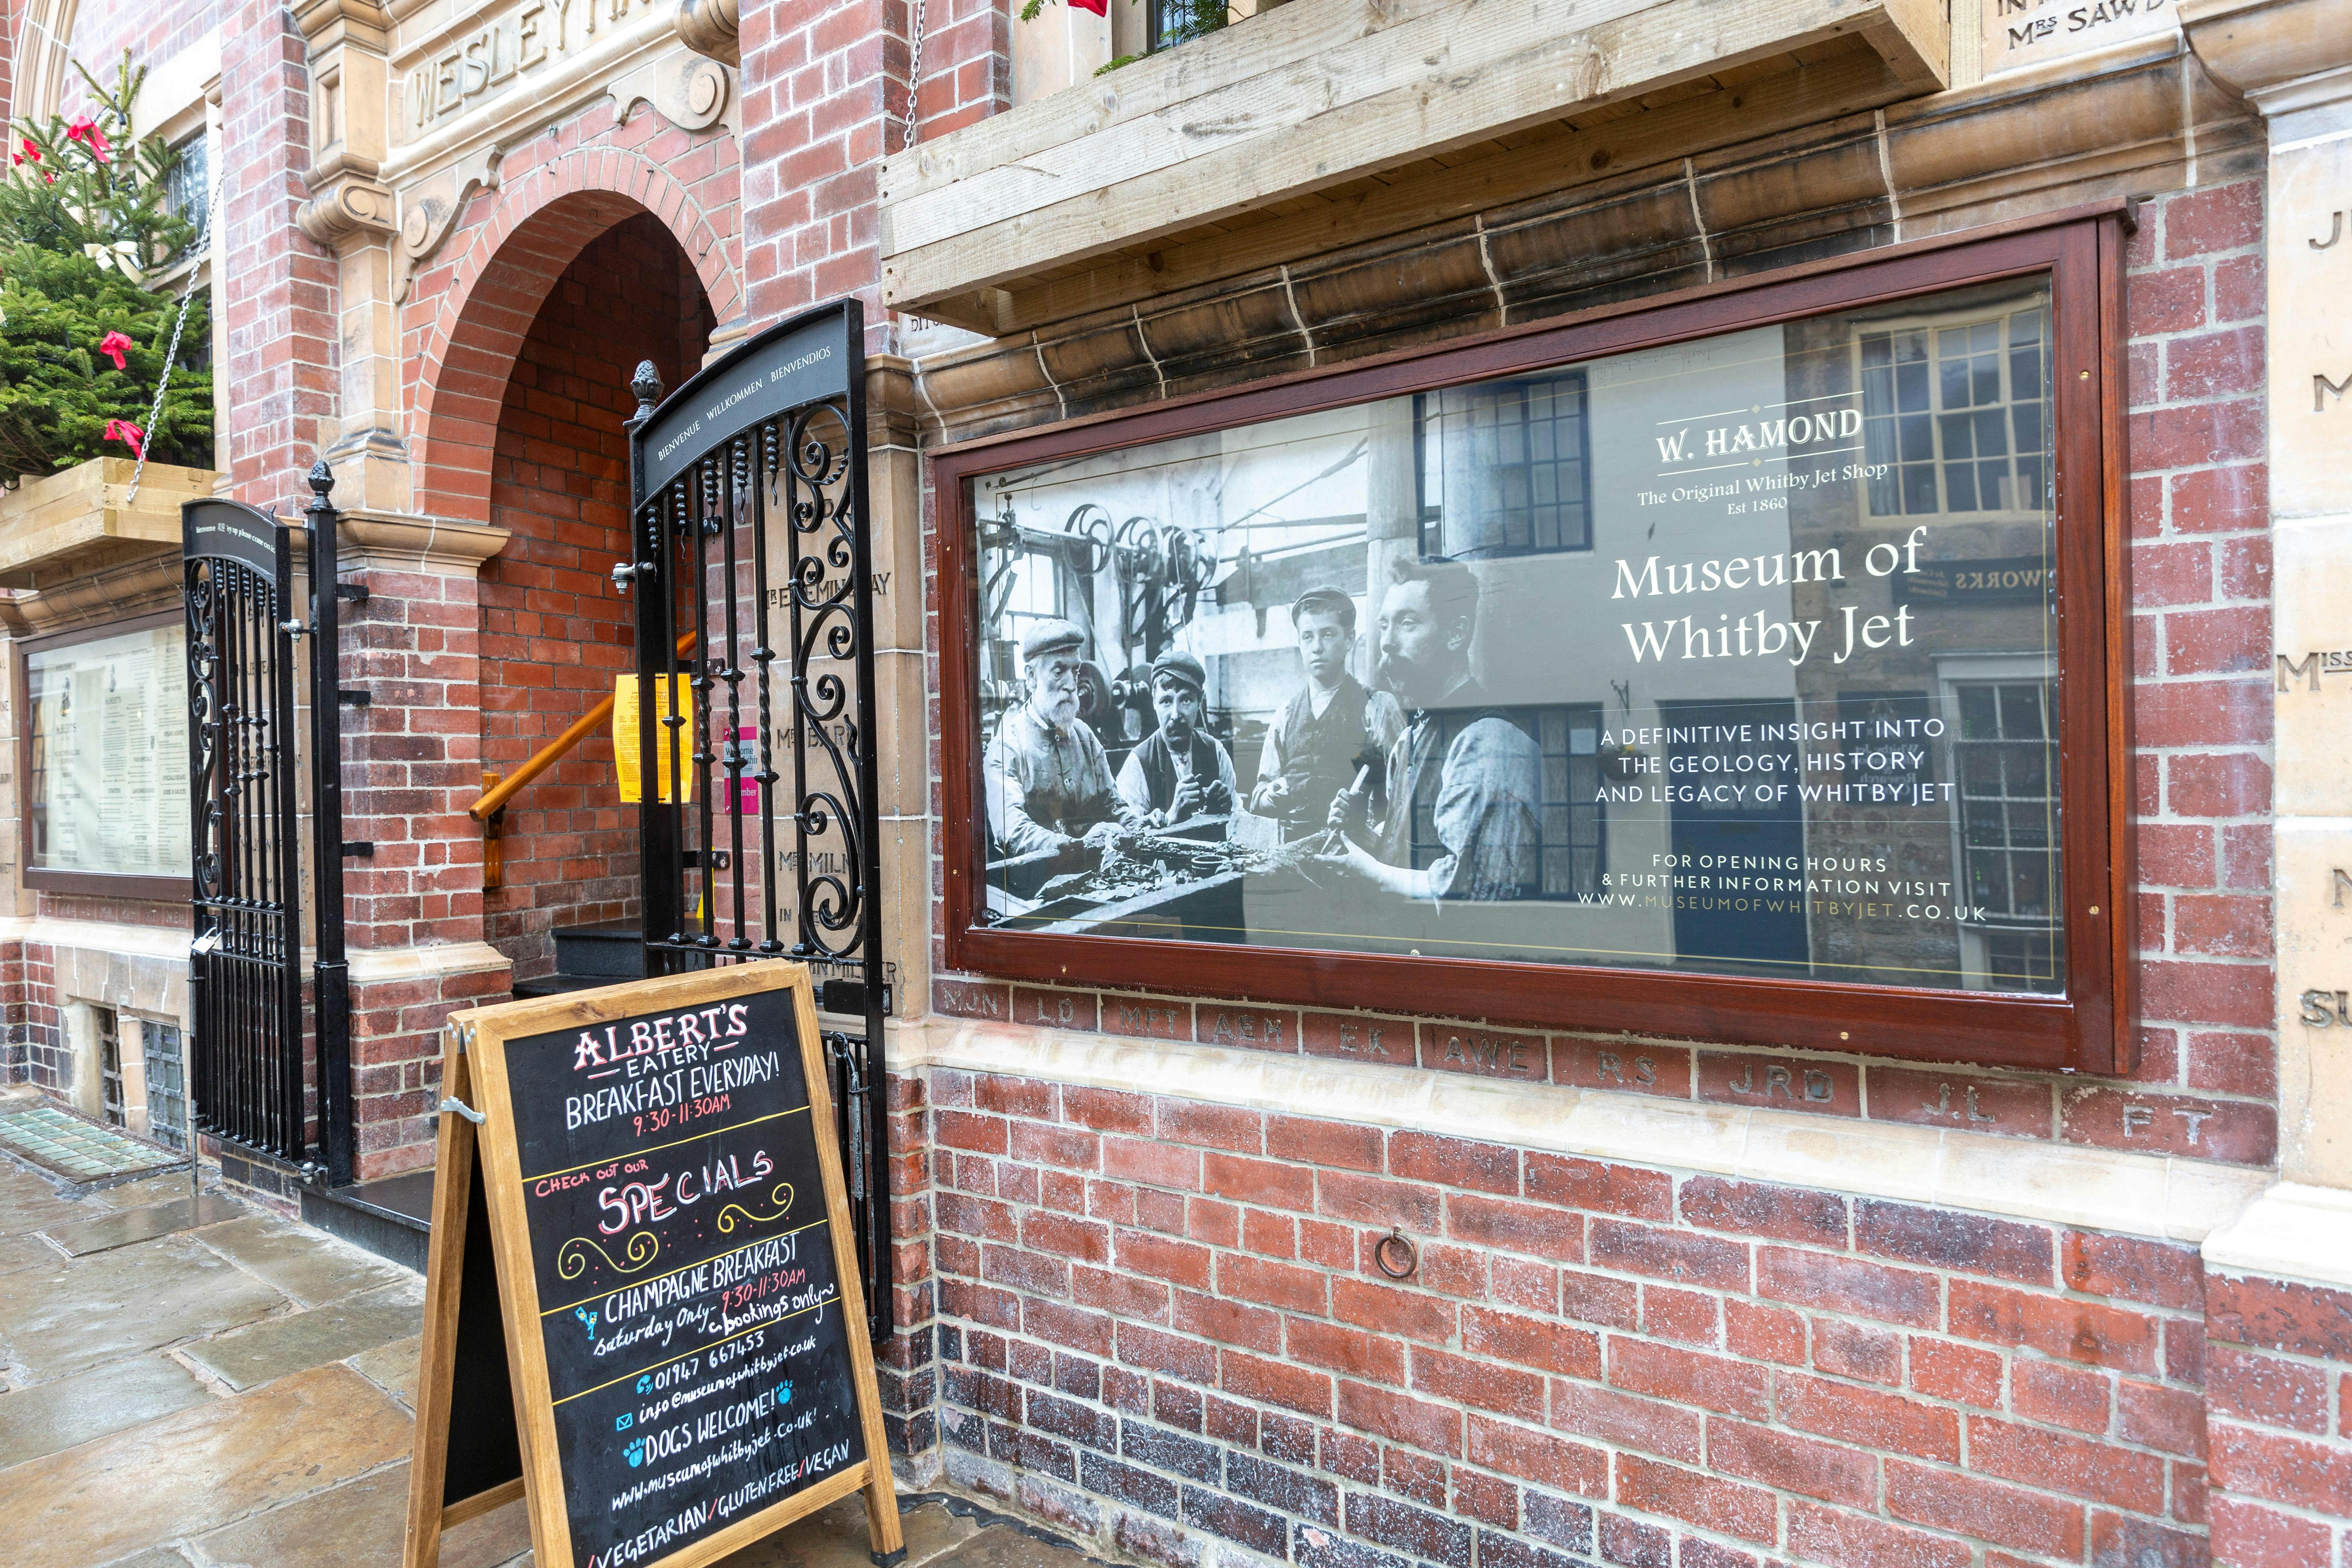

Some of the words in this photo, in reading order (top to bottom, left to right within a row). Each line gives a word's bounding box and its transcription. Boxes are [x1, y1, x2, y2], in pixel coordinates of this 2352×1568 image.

[658, 420, 701, 461] BIENVENUE
[706, 378, 763, 421] WILLKOMMEN
[770, 346, 831, 383] BIENVENDIOS
[1656, 427, 1695, 464] W.
[1705, 409, 1864, 457] HAMOND
[1637, 492, 1667, 506] The
[1672, 480, 1740, 503] Original
[1746, 472, 1810, 492] Whitby
[1812, 469, 1837, 489] Jet
[1842, 463, 1888, 482] Shop
[1727, 502, 1746, 515] Est
[1752, 497, 1788, 512] 1860
[264, 541, 270, 550] on
[1611, 546, 1845, 599] Museum
[1865, 525, 1927, 577] of
[1621, 609, 1822, 666] Whitby
[1834, 604, 1915, 664] Jet
[1600, 730, 1615, 745] A
[1622, 725, 1752, 745] DEFINITIVE
[1761, 721, 1866, 741] INSIGHT
[1876, 719, 1944, 738] INTO
[1618, 757, 1661, 773] THE
[1669, 754, 1798, 774] GEOLOGY,
[1807, 751, 1925, 771] HISTORY
[741, 788, 757, 796] mber
[1595, 786, 1643, 802] AND
[1652, 785, 1747, 802] LEGACY
[1755, 784, 1788, 802] OF
[1797, 784, 1904, 802] WHITBY
[1911, 783, 1955, 806] JET
[1602, 873, 1613, 886] &
[1621, 874, 1711, 889] FURTHER
[1719, 876, 1878, 894] INFORMATION
[1888, 881, 1951, 896] VISIT
[1653, 854, 1692, 867] FOR
[1699, 855, 1798, 870] OPENING
[1807, 857, 1886, 872] HOURS
[1577, 893, 1986, 921] WWW.MUSEUMOFWHITBYJET.CO.UK
[574, 1003, 749, 1071] ALBERT'S
[627, 1041, 710, 1078] EATERY
[566, 1069, 684, 1130] BREAKFAST
[690, 1051, 780, 1098] EVERYDAY!
[596, 1163, 619, 1181] OUT
[625, 1159, 649, 1173] OUR
[598, 1150, 773, 1234] SPECIALS
[605, 1264, 709, 1323] CHAMPAGNE
[713, 1231, 800, 1289] BREAKFAST
[655, 1357, 699, 1390] 01947
[709, 1330, 765, 1369] 667453
[644, 1423, 693, 1466] DOGS
[697, 1388, 775, 1445] WELCOME!
[597, 1500, 707, 1568] VEGETARIAN
[717, 1478, 766, 1519] GLUTEN
[804, 1438, 850, 1476] VEGAN
